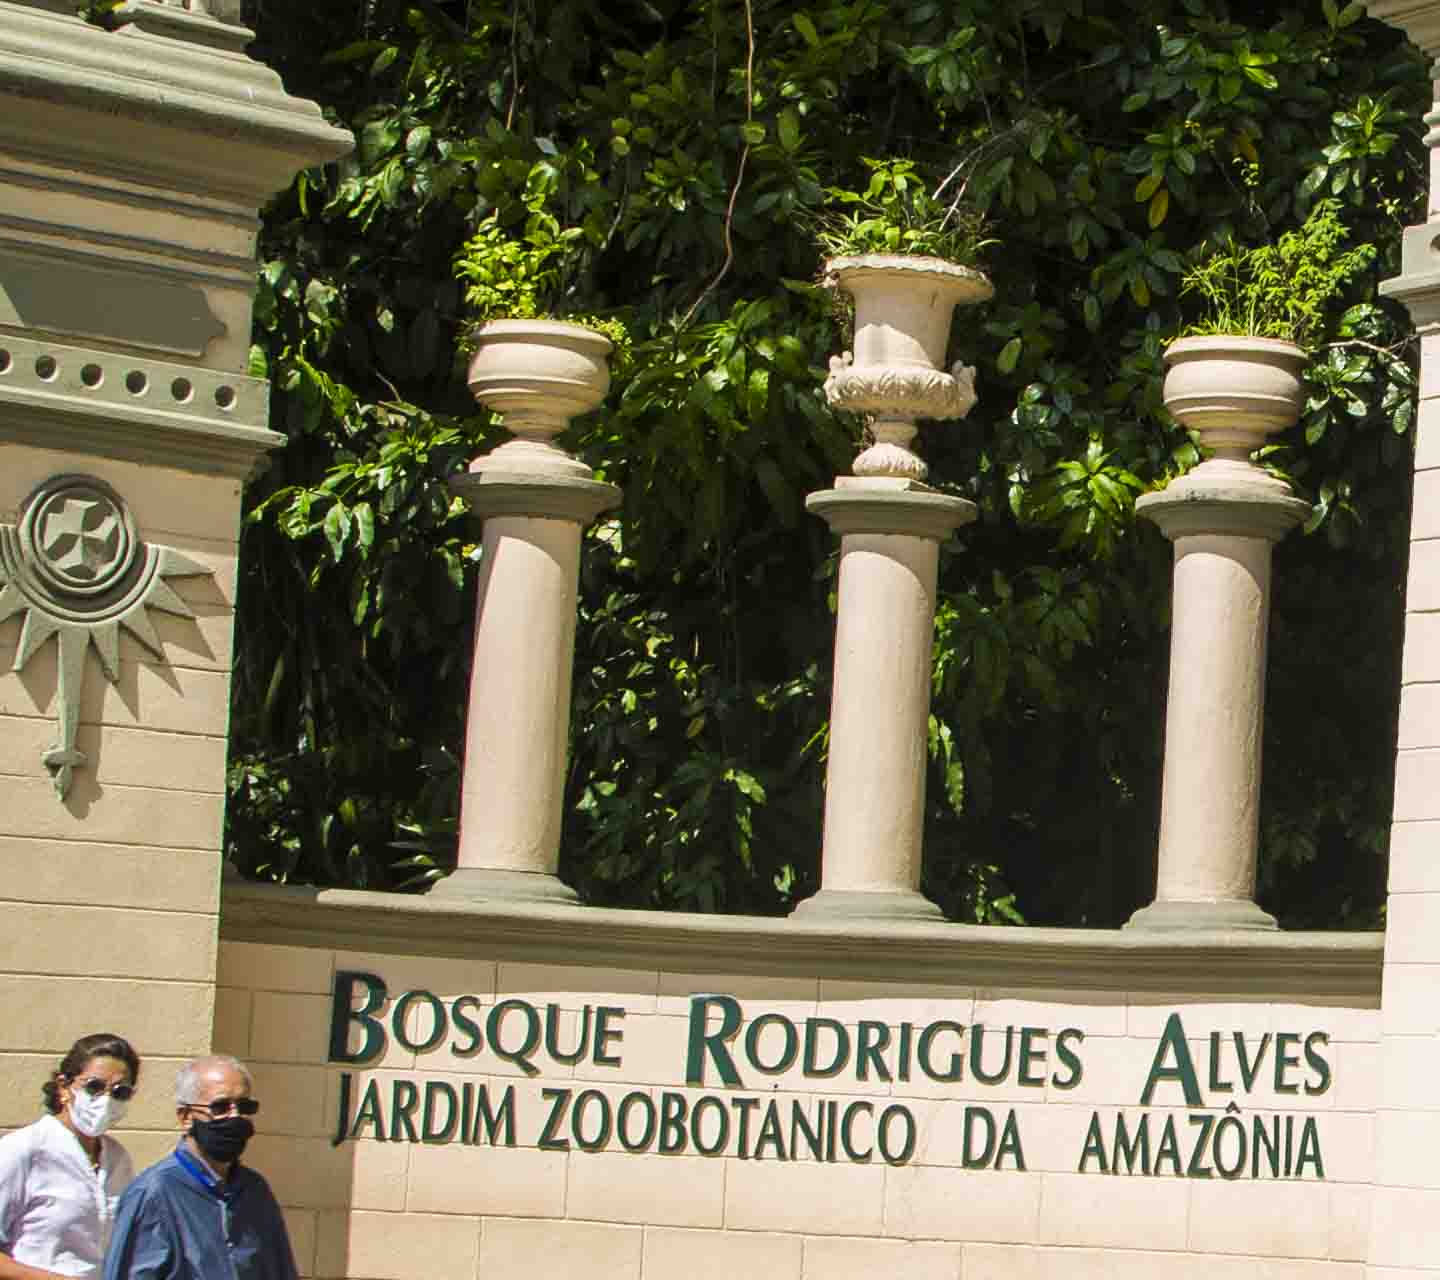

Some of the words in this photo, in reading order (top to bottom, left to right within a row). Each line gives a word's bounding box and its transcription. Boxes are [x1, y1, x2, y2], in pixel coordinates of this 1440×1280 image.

[326, 969, 626, 1078] BOSQUE
[685, 992, 1086, 1092] RODRIGUES
[1139, 1011, 1334, 1108] ALVES
[332, 1072, 518, 1149] JARDIM
[962, 1106, 1027, 1172] DA
[1077, 1100, 1326, 1181] AMAZÔNIA
